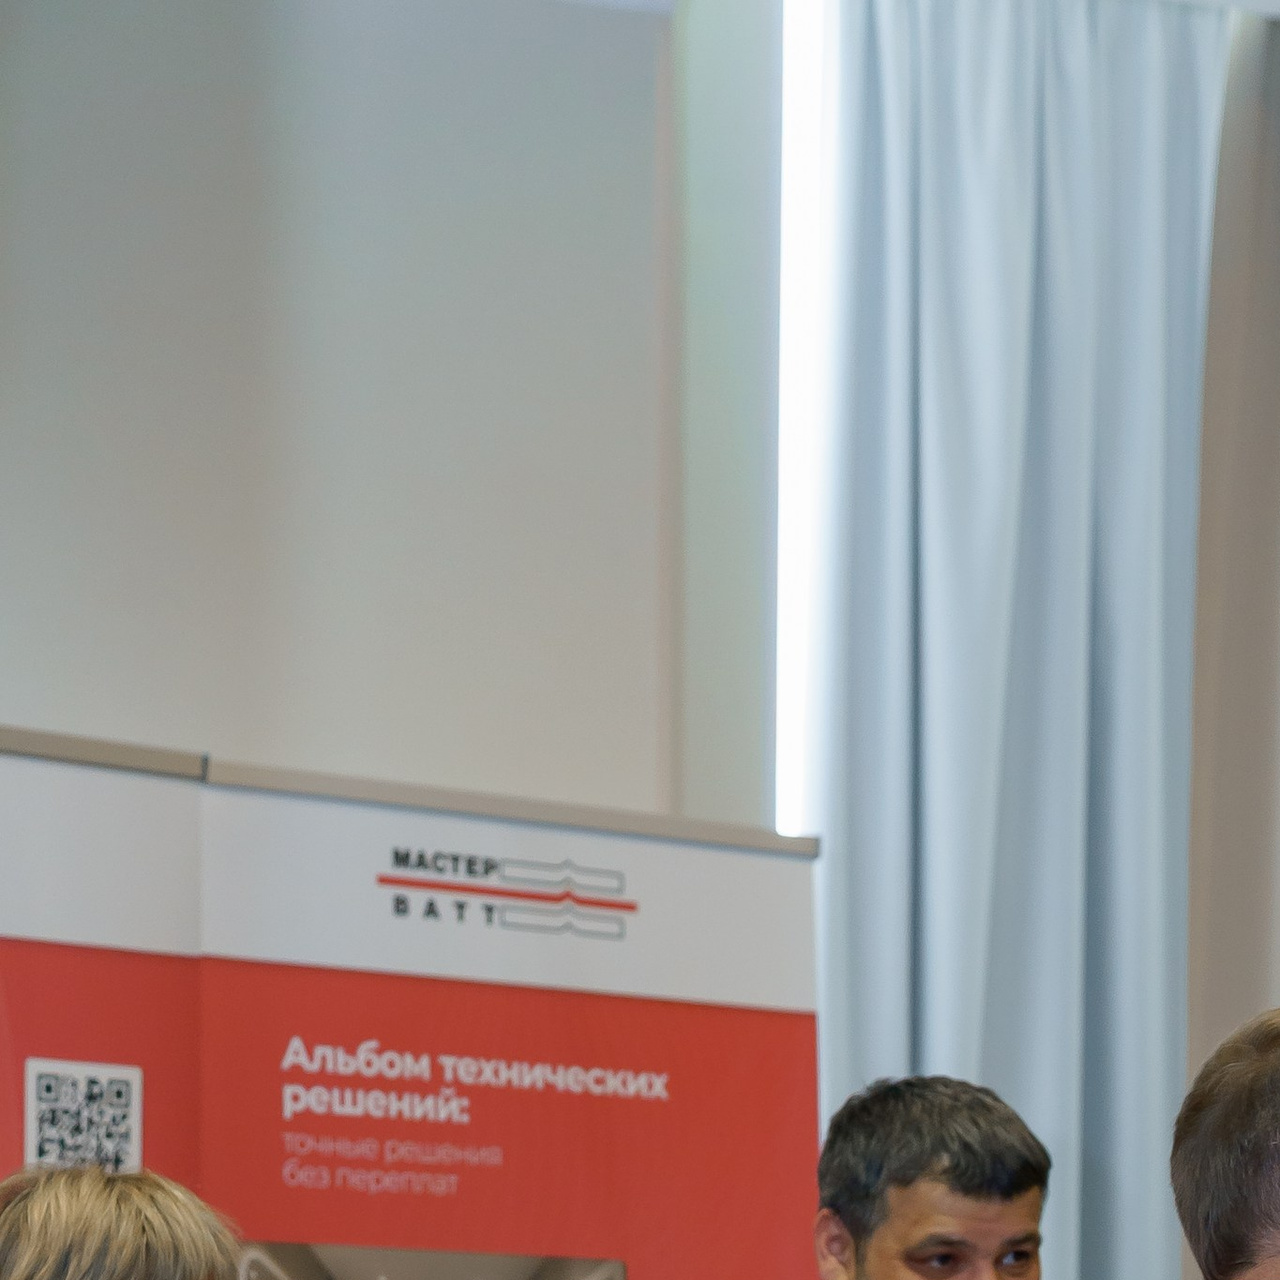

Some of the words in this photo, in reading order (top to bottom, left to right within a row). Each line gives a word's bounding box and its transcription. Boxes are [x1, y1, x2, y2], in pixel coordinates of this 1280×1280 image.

[392, 848, 499, 876] МАСТЕР
[393, 895, 497, 926] ВАТТ
[281, 1035, 431, 1081] Альбом
[439, 1054, 671, 1100] технических
